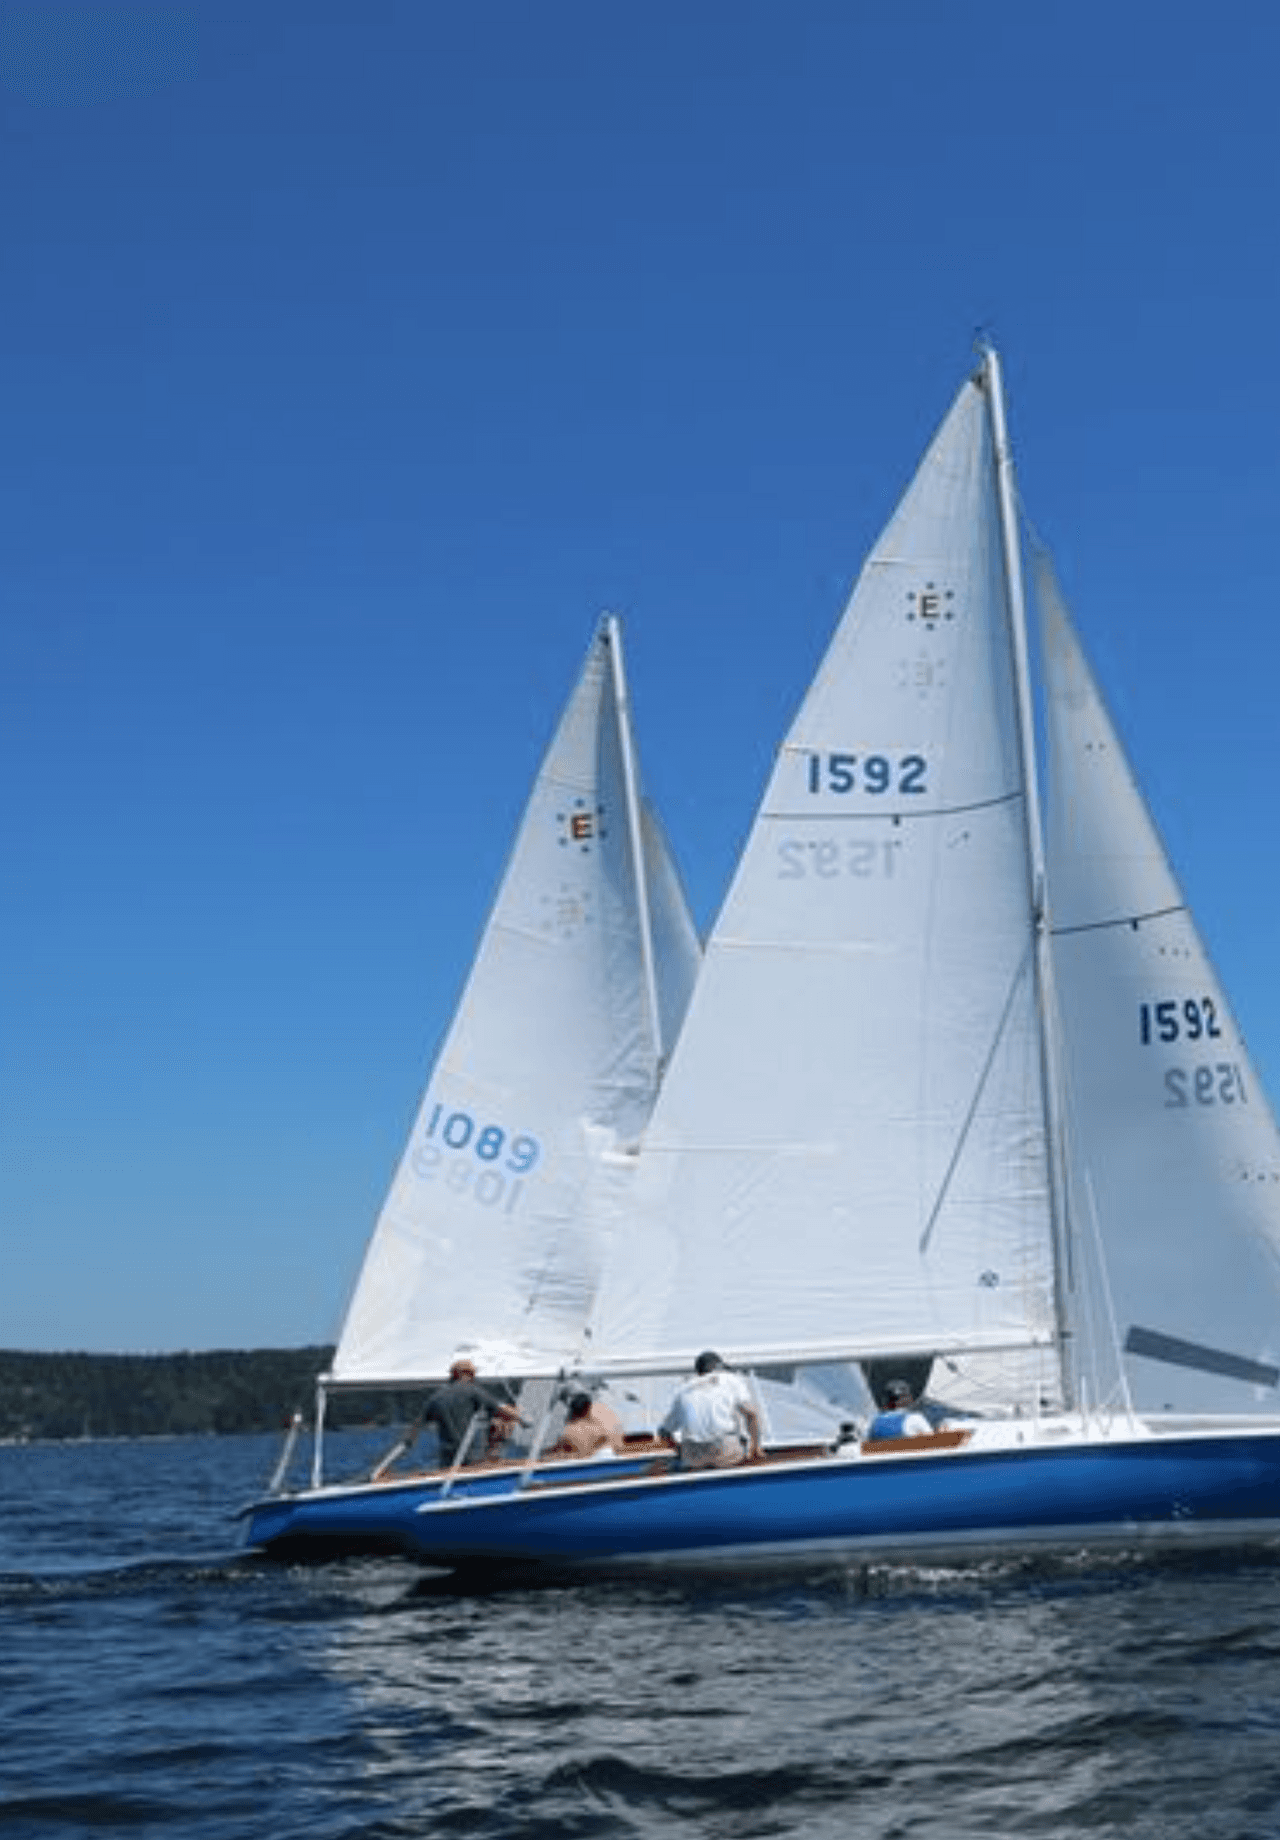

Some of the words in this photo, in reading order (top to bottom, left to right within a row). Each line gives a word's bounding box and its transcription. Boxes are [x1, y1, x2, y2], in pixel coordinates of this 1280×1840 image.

[920, 595, 940, 618] E
[807, 754, 928, 794] 1592
[571, 812, 593, 839] E
[1140, 996, 1221, 1045] 1592
[425, 1103, 540, 1174] 1089
